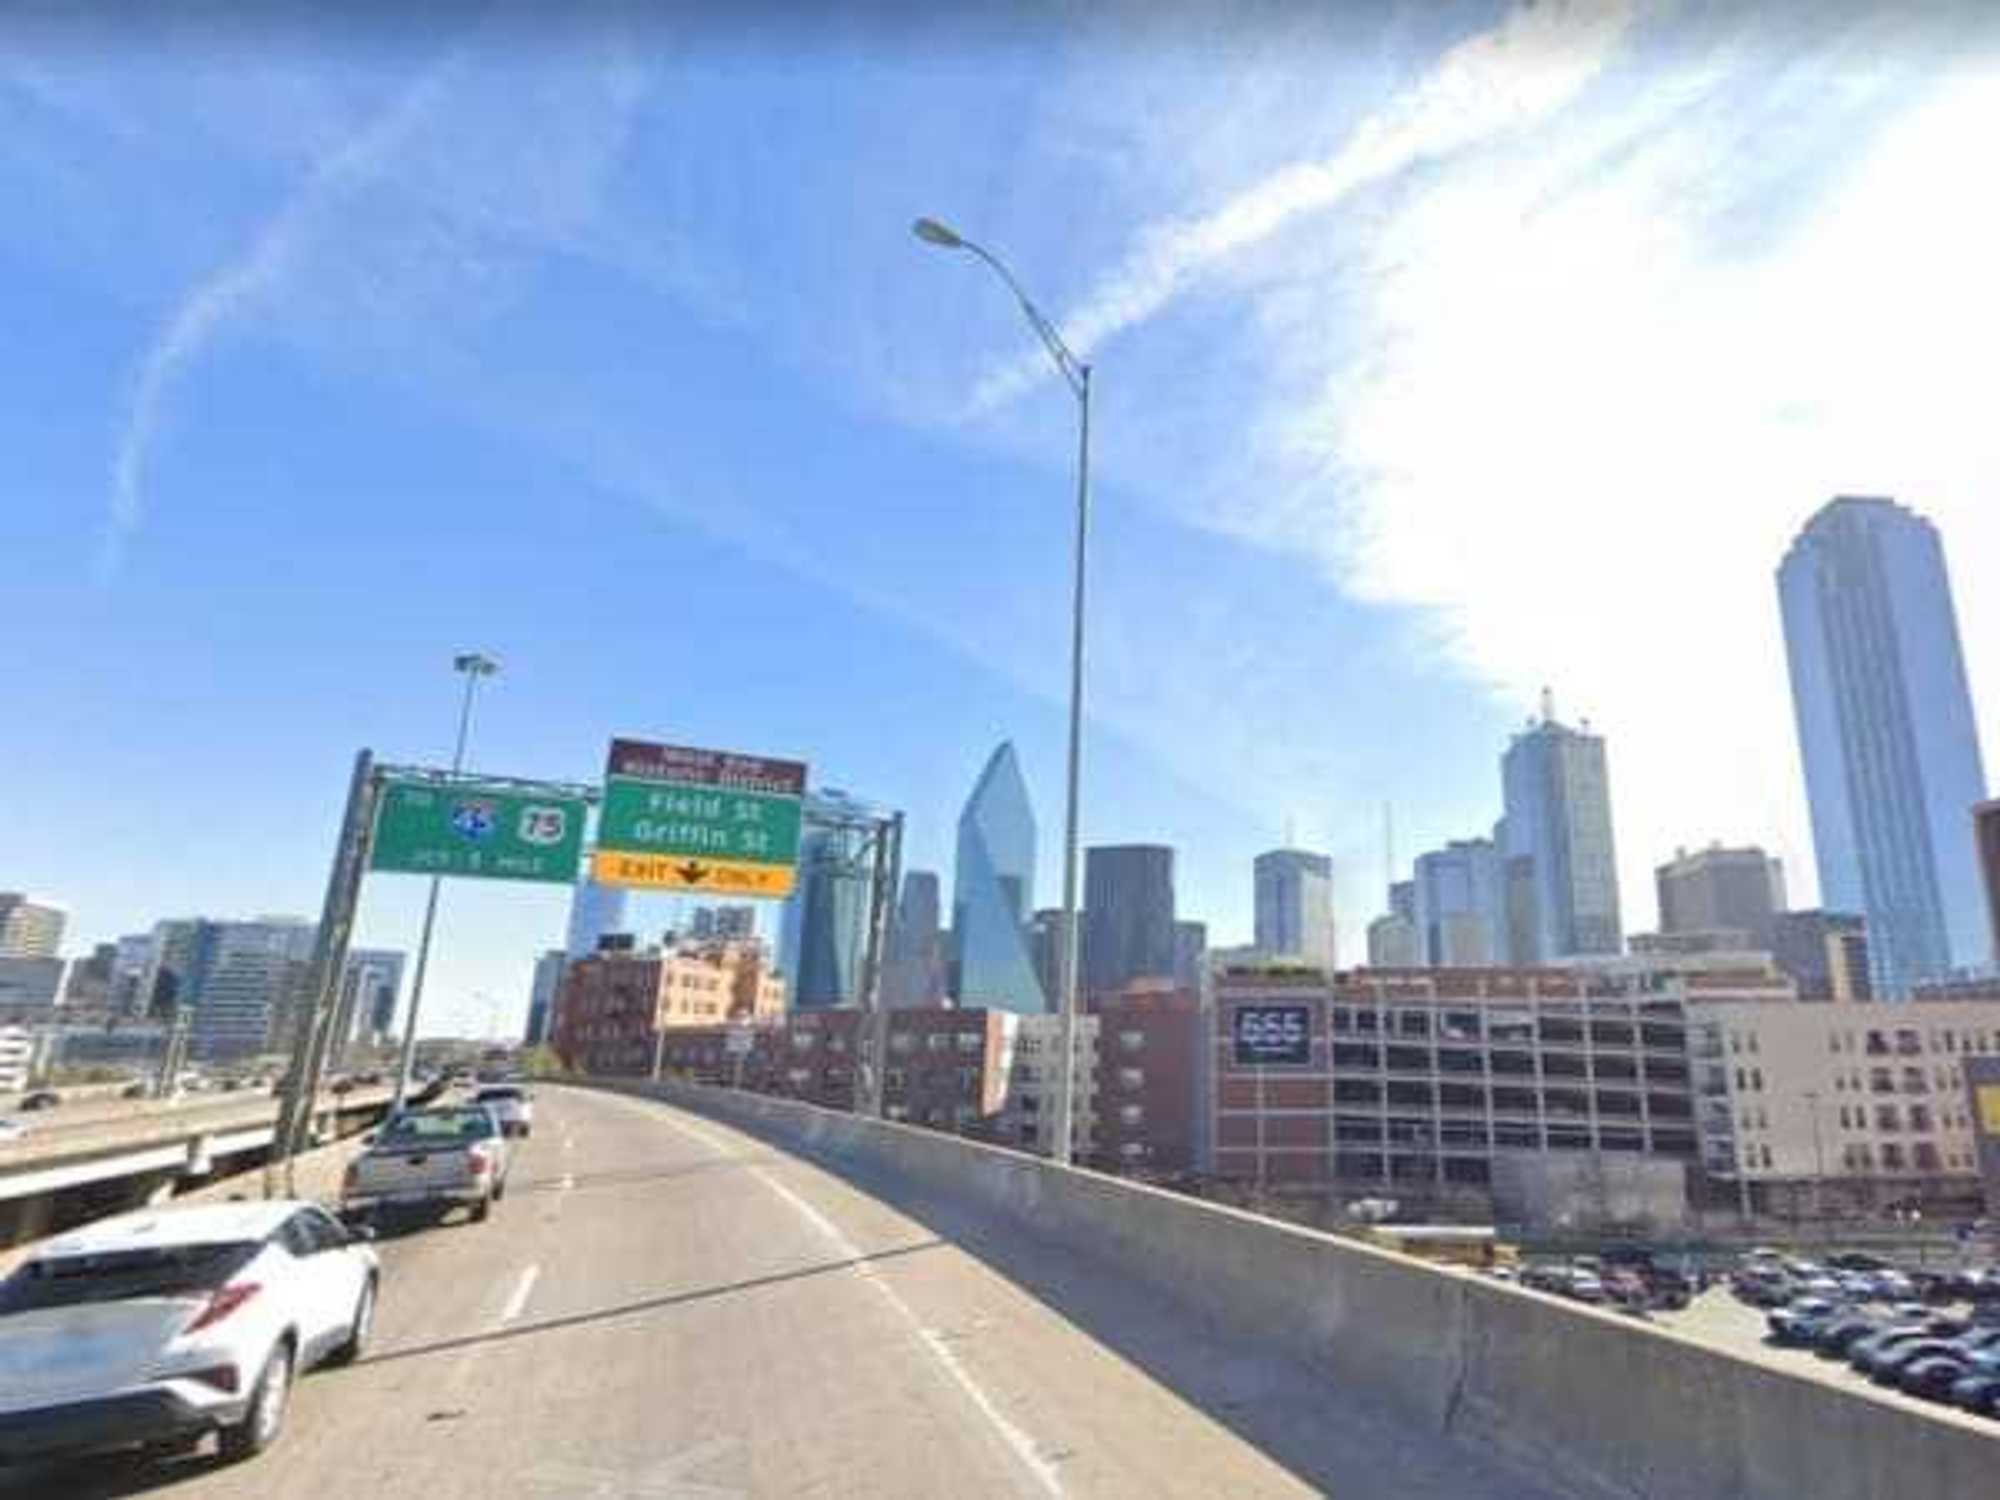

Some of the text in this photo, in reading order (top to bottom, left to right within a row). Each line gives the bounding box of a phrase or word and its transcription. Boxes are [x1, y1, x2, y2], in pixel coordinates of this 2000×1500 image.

[650, 791, 722, 818] Field
[634, 818, 769, 851] Griffin St
